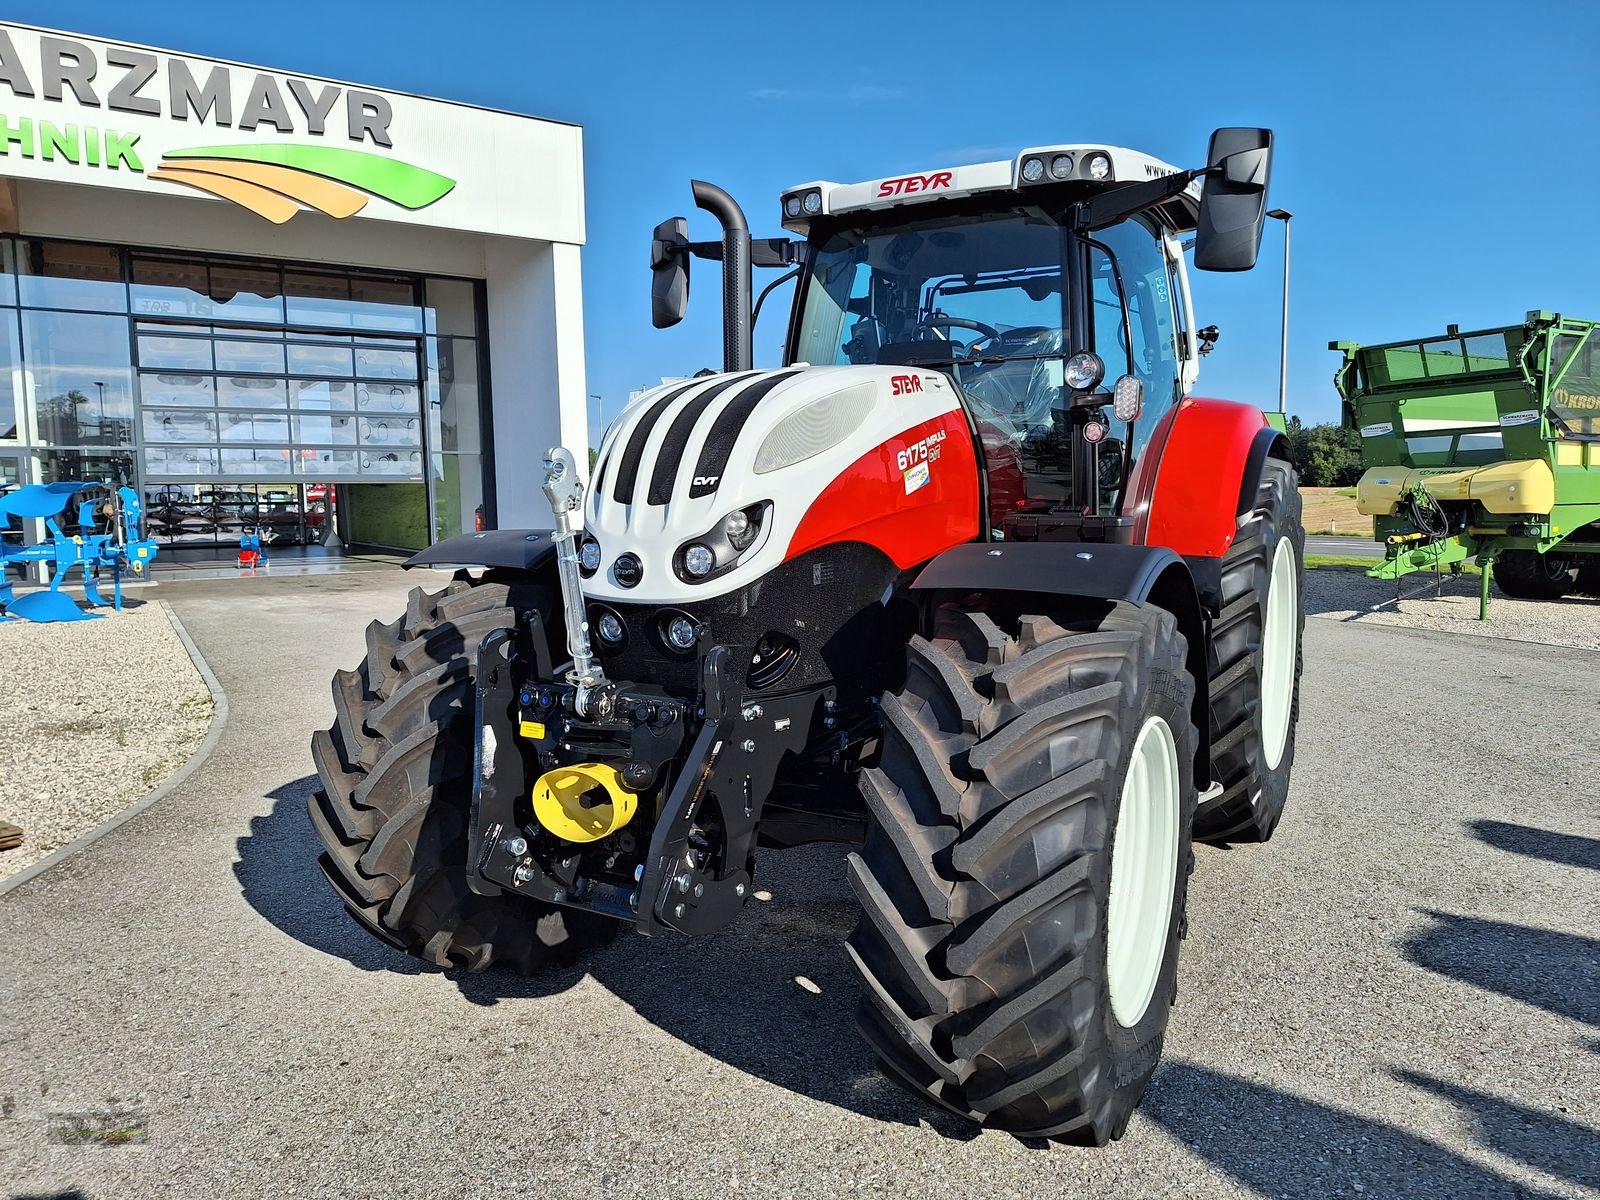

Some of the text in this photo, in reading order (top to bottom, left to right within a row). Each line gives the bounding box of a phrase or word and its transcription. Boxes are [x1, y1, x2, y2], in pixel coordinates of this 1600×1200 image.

[0, 113, 144, 173] HNIK
[877, 171, 953, 198] STEYR
[891, 374, 923, 396] STEYR
[897, 429, 947, 472] 6175 IMPULS
[693, 476, 719, 486] CVT
